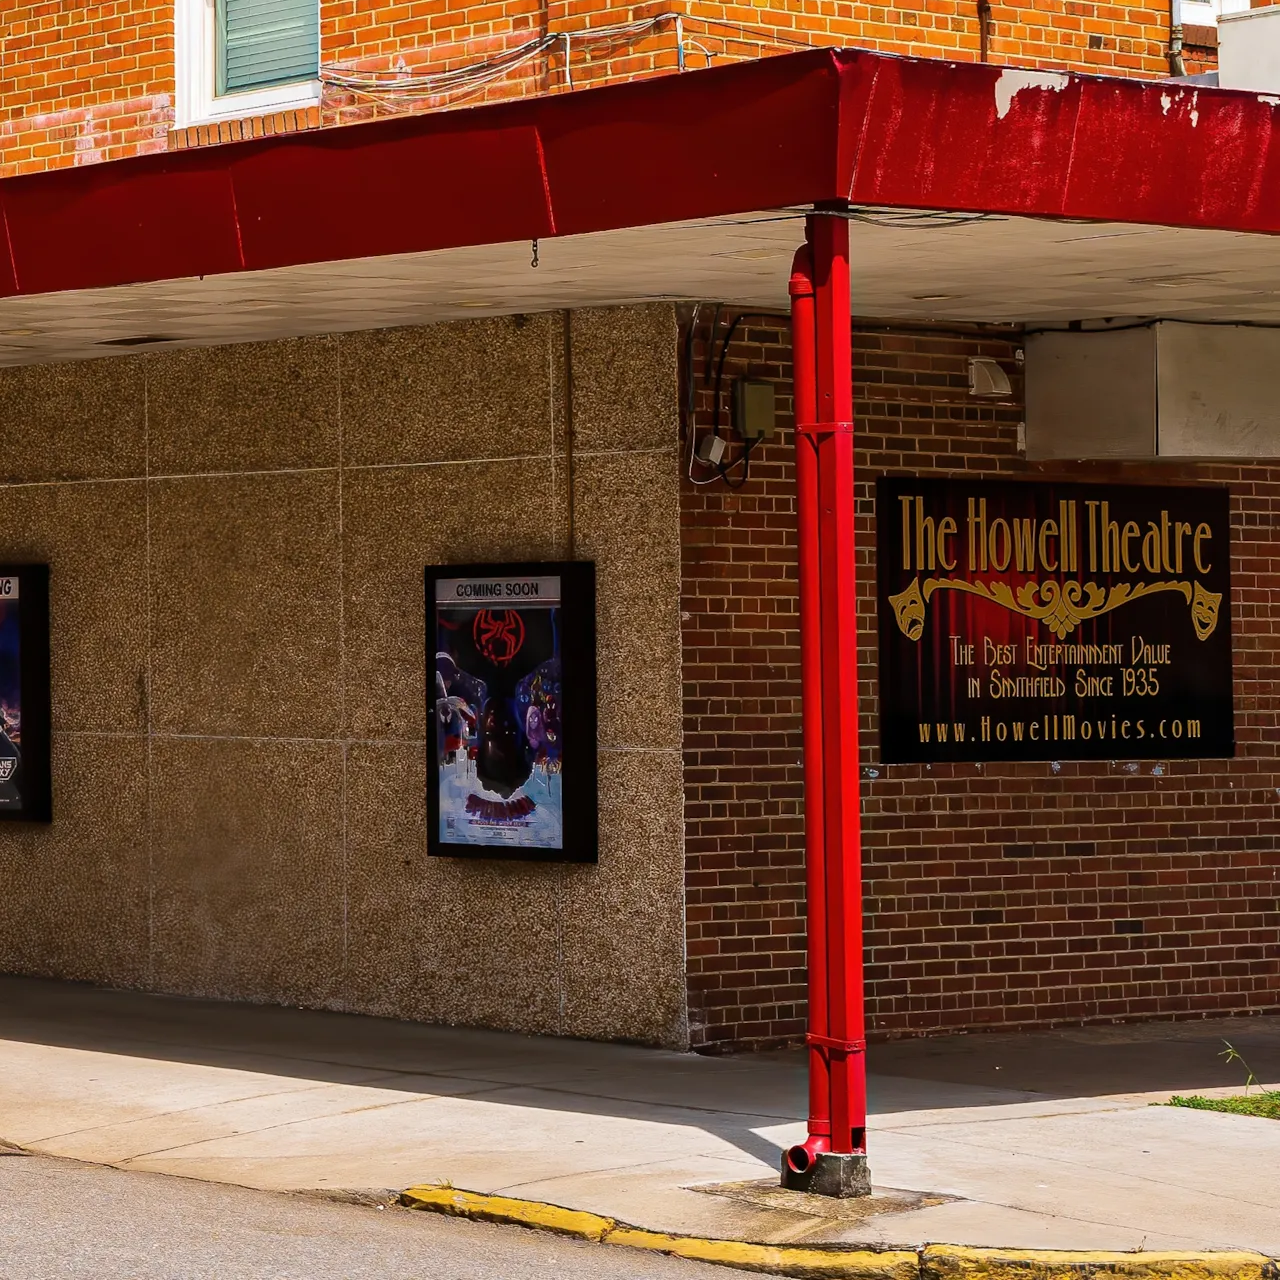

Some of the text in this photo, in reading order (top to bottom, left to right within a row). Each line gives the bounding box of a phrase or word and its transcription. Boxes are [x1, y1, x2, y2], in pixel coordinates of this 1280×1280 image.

[897, 495, 1213, 574] The Howell Theatre
[455, 582, 539, 597] COMING SOON
[1122, 668, 1160, 697] 1935
[918, 714, 1202, 744] www.HowellMovies.com
